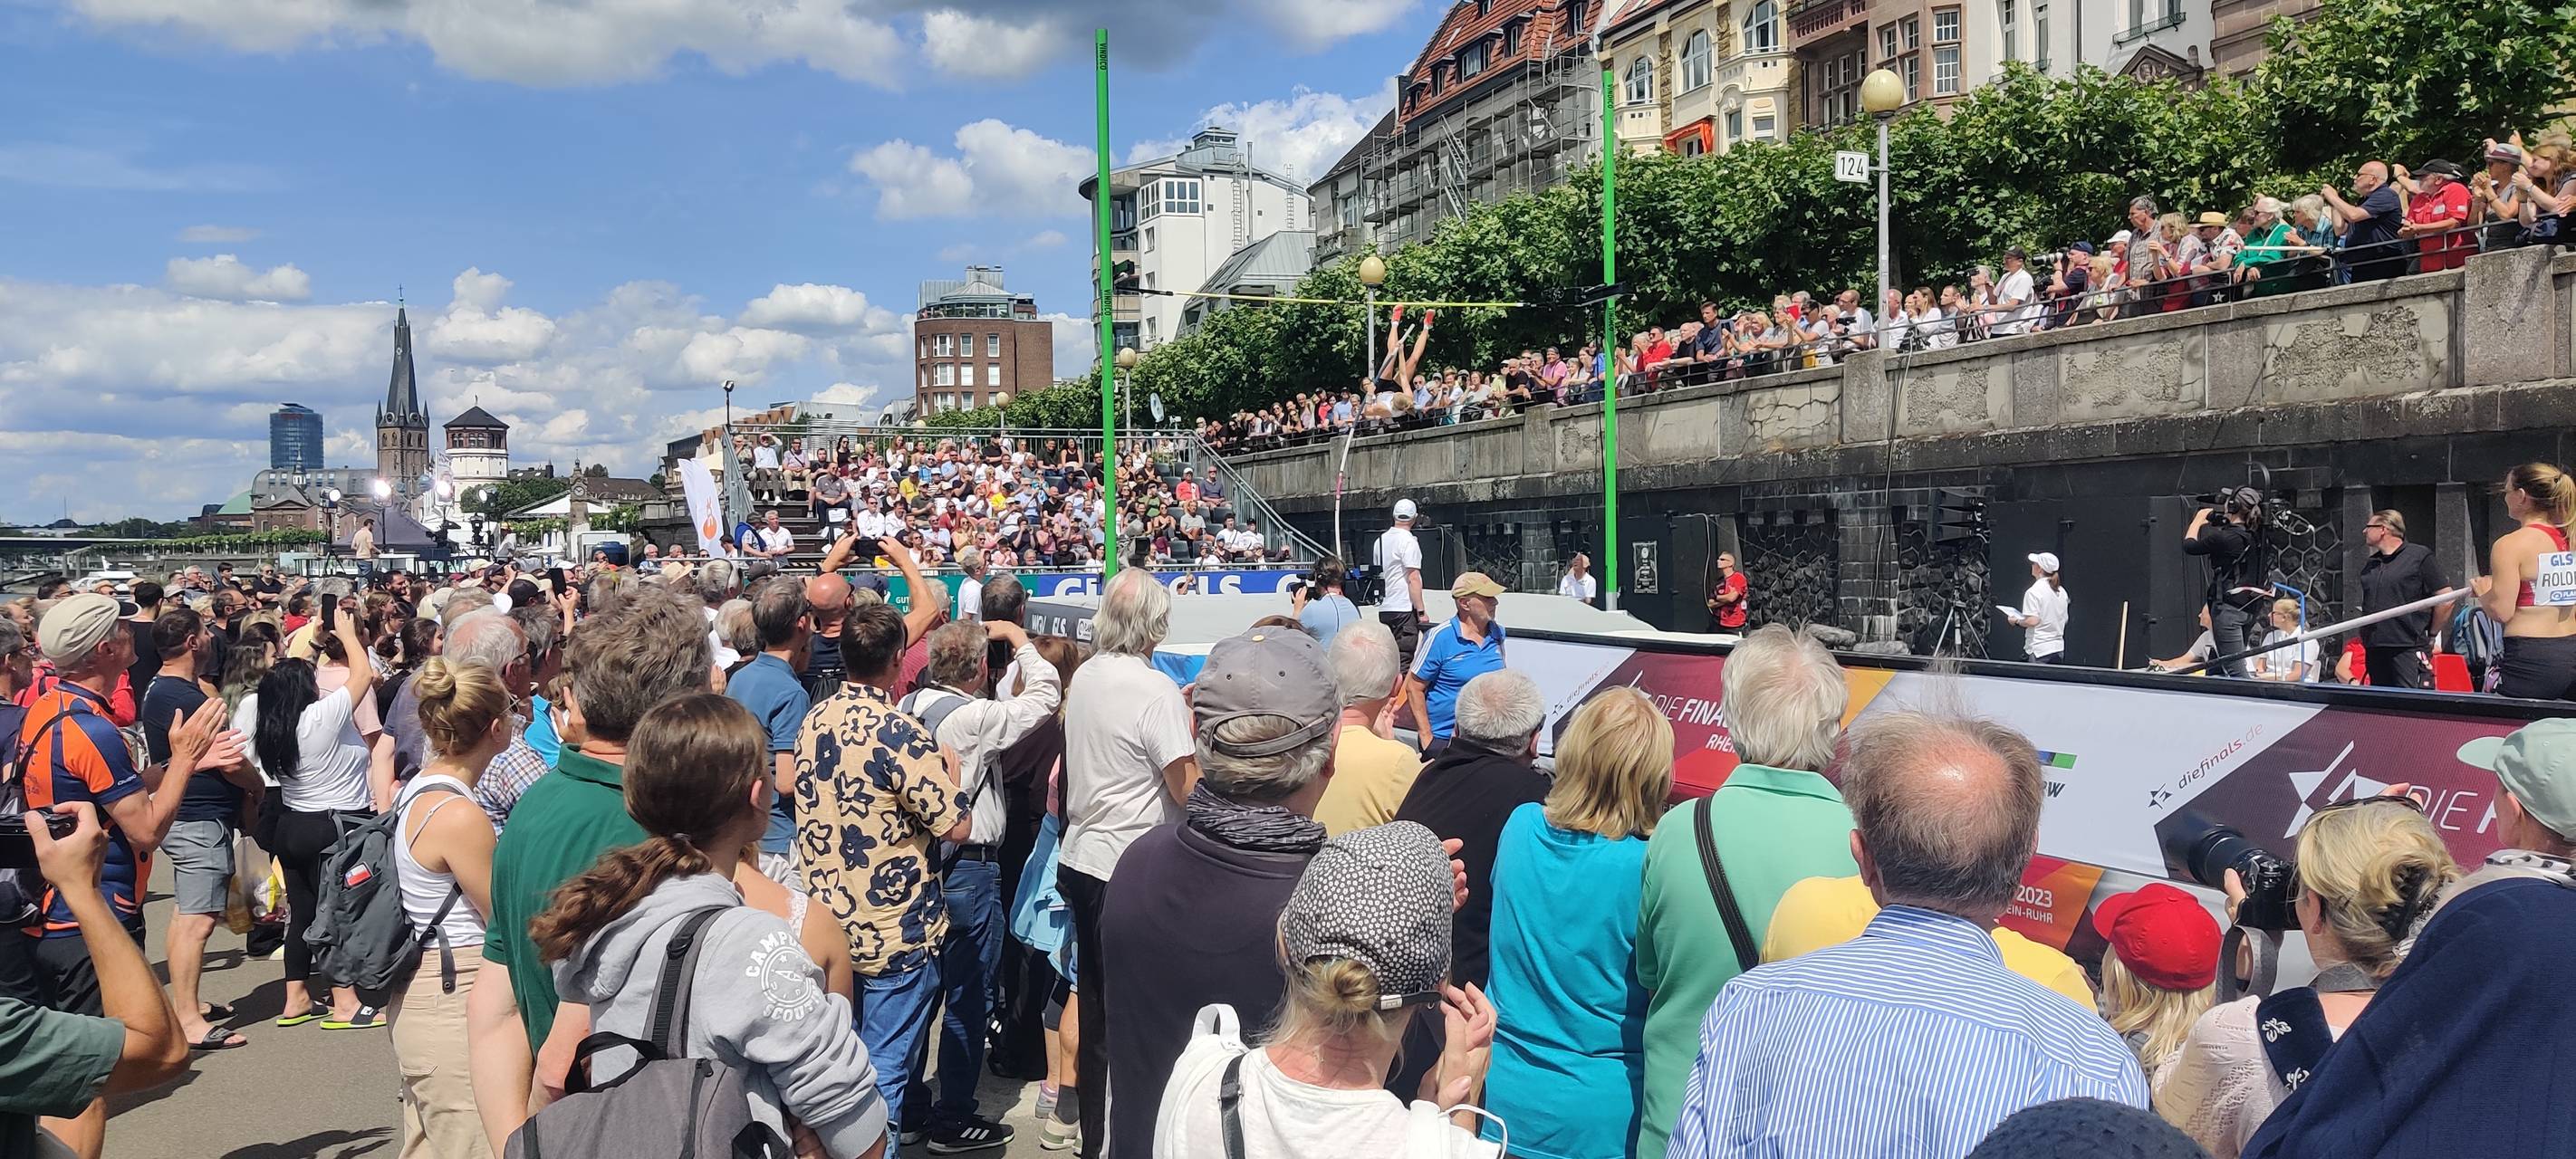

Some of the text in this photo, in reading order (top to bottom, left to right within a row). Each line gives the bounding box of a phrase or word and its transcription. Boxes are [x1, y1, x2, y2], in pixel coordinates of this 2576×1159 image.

[1099, 43, 1108, 71] VINDICO
[1841, 157, 1864, 177] 124
[1103, 289, 1112, 316] VINDICO
[2550, 553, 2574, 567] GLS
[2178, 723, 2264, 790] diefinals.de
[2016, 885, 2052, 908] 2023
[2007, 905, 2053, 924] EIN-RUHR
